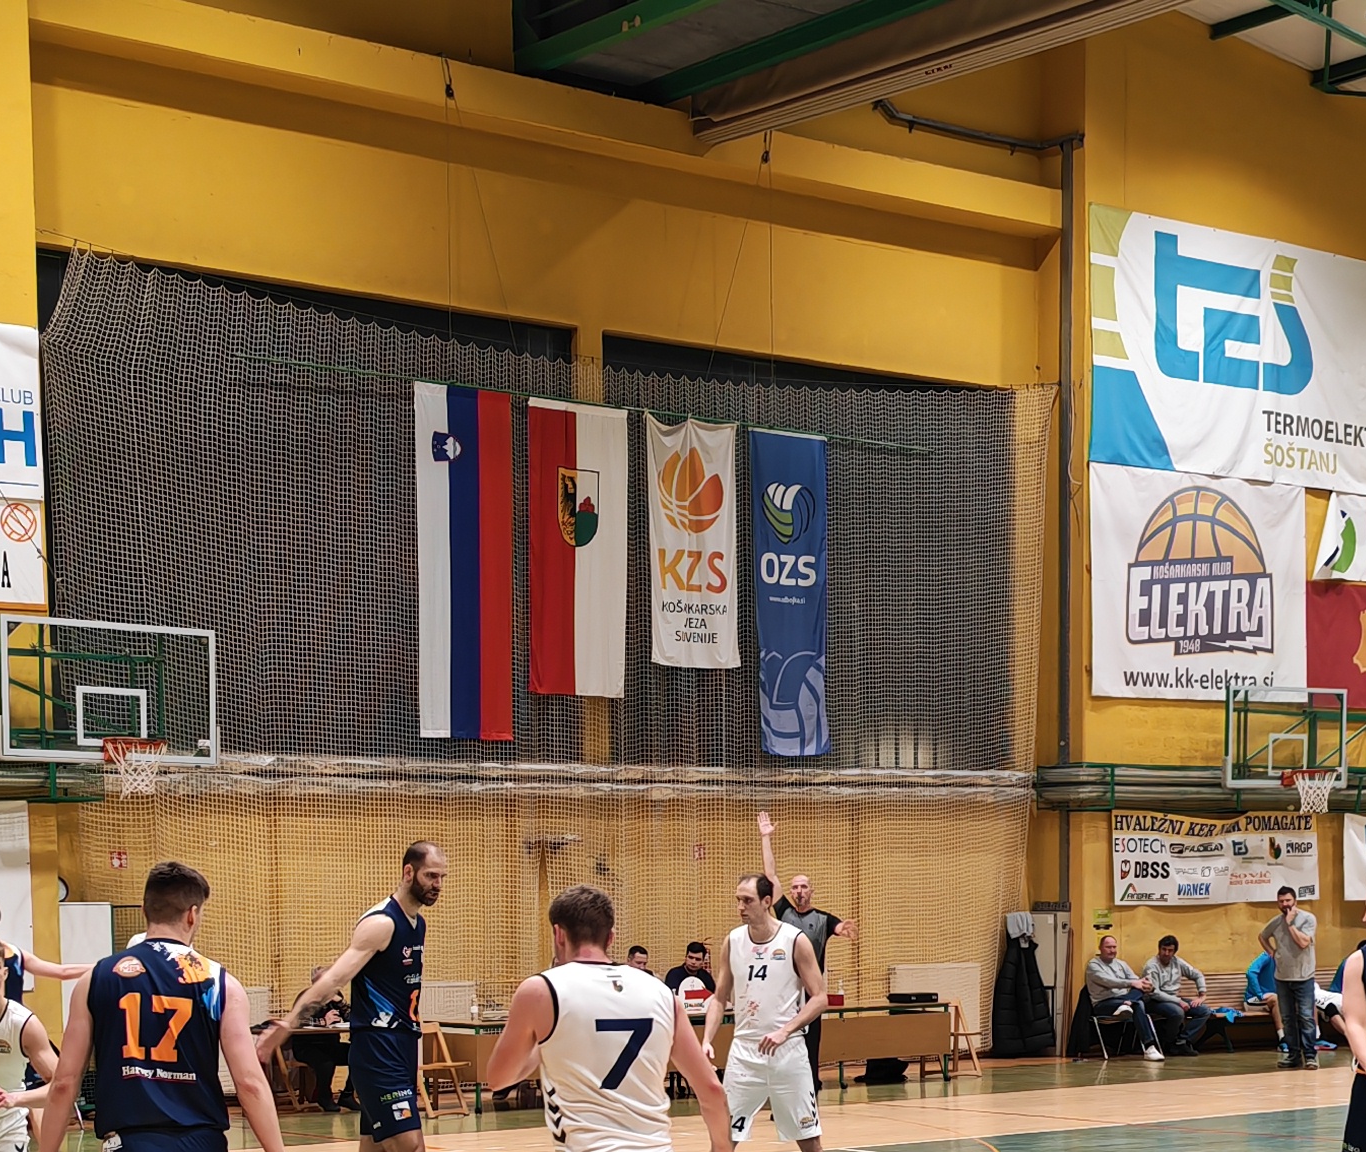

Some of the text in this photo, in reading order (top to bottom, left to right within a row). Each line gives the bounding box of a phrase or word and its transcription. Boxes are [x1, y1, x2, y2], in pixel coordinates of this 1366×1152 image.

[1263, 438, 1338, 475] ŠOŠTANJ
[658, 549, 727, 594] KZS
[760, 552, 817, 587] OZS
[1212, 561, 1231, 576] KLUB
[1129, 566, 1271, 649] ELEKTRA
[1179, 639, 1201, 653] 1948
[1124, 667, 1274, 690] www.kk-elektrasi
[1114, 814, 1185, 835] HVALEŽNI
[1185, 821, 1218, 837] KER
[1244, 815, 1313, 832] POMAGATE
[1134, 861, 1170, 879] DBSS
[748, 964, 768, 981] 14
[119, 992, 193, 1063] 17
[595, 1018, 654, 1090] 7
[156, 1068, 197, 1081] Norman
[731, 1116, 746, 1132] 4
